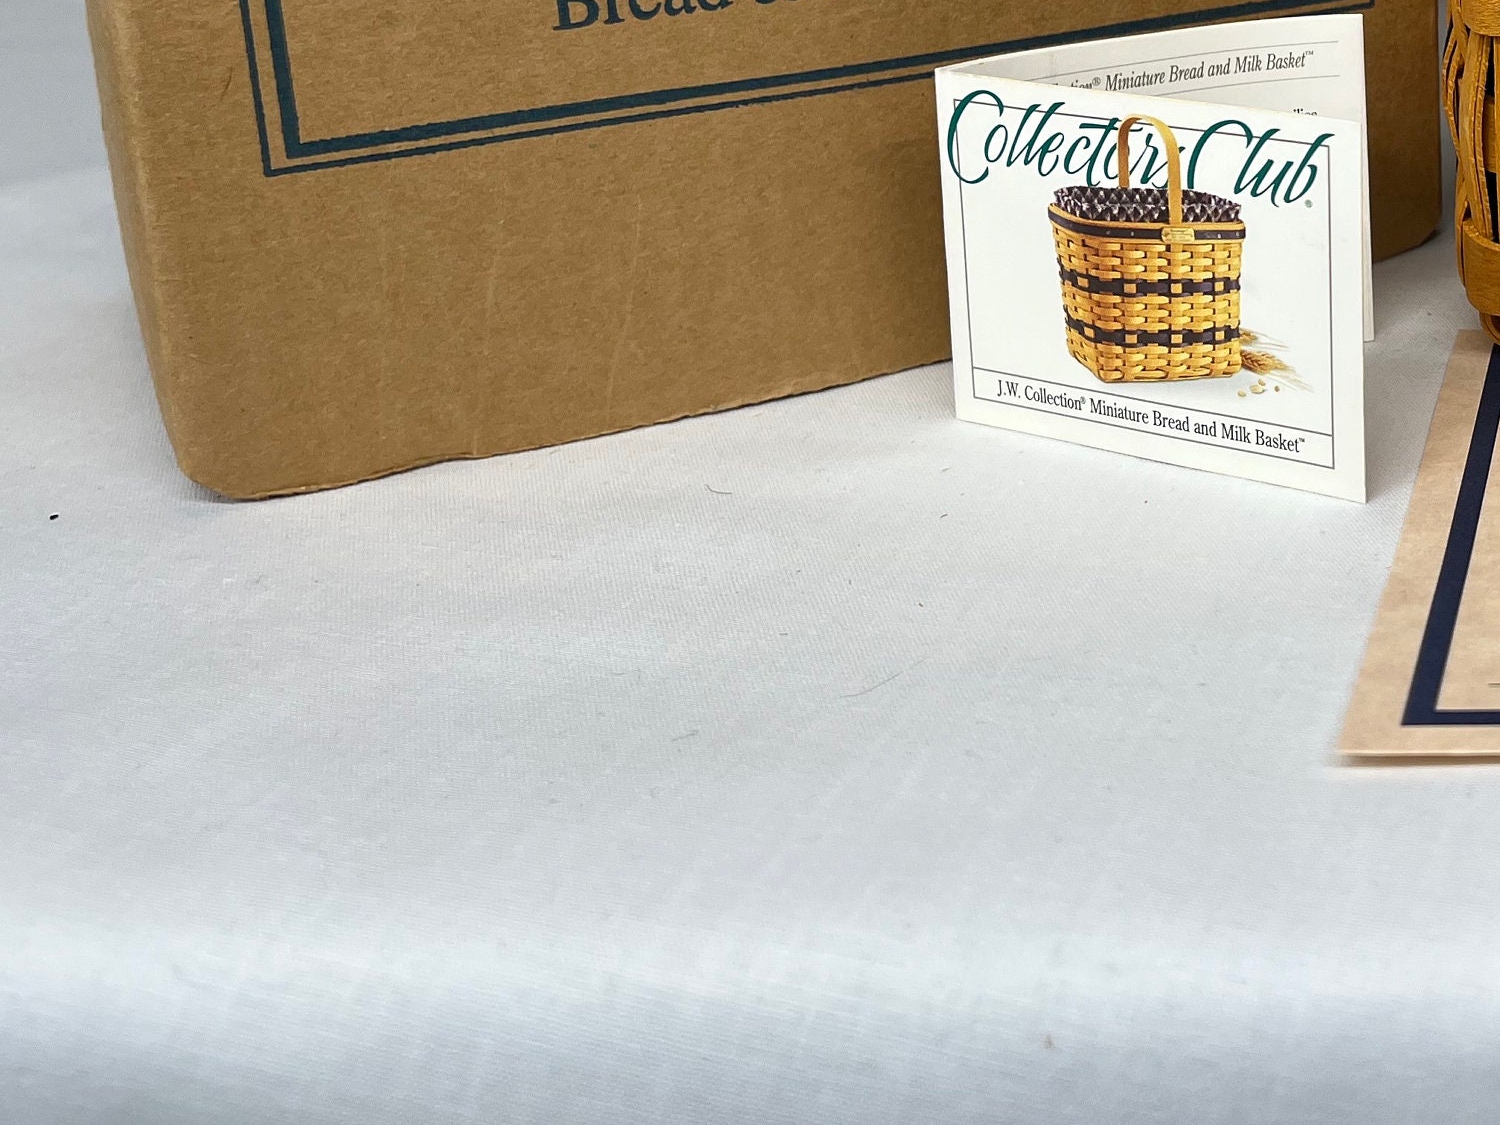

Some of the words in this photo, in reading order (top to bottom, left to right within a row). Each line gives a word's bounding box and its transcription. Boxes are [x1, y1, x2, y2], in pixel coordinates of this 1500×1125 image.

[1105, 71, 1166, 92] Miniature
[1169, 62, 1204, 83] Bread
[1207, 59, 1230, 77] and
[1233, 54, 1263, 73] Milk
[1266, 50, 1314, 68] Basket™
[997, 379, 1021, 399] J.W.
[1024, 384, 1086, 411] Collection®
[1090, 397, 1149, 425] Miniature
[1153, 410, 1190, 433] Bread
[1194, 417, 1217, 438] and
[1221, 422, 1252, 444] Milk
